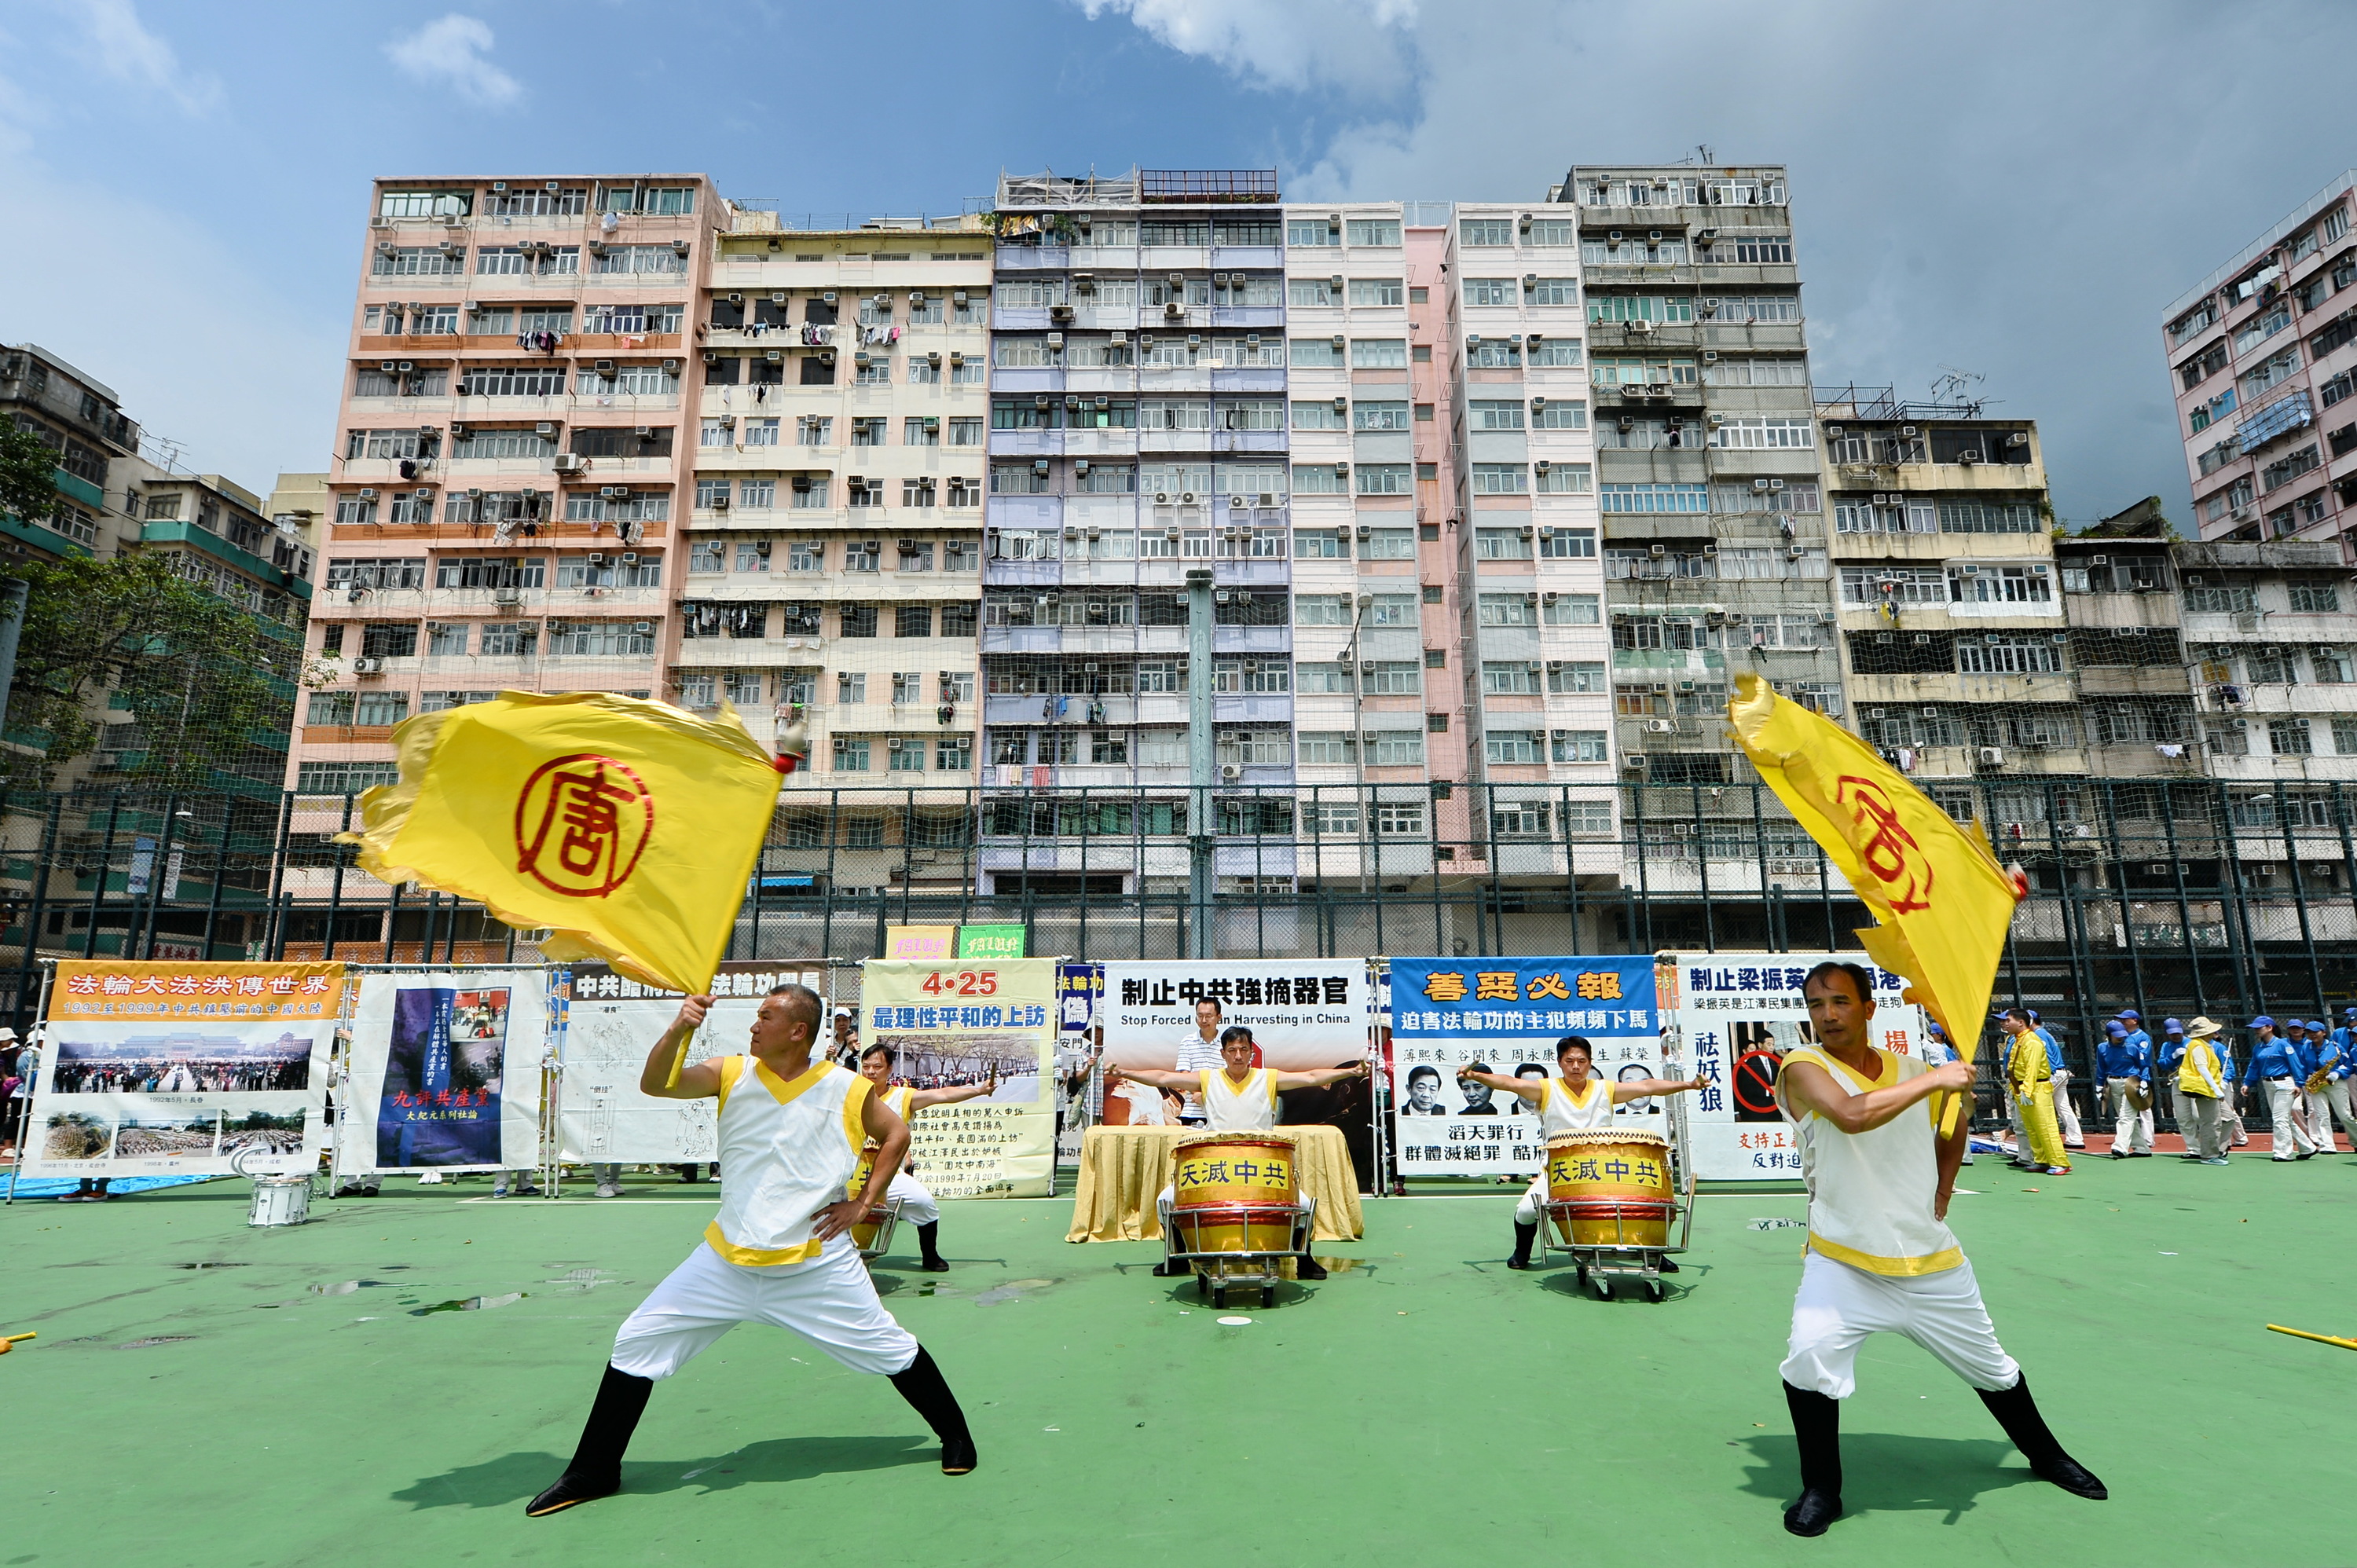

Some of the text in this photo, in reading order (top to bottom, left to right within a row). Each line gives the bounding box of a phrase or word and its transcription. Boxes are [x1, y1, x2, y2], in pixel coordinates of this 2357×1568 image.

[68, 973, 331, 997] 法輪大法洪傳世界
[1121, 976, 1349, 1006] 制止中共強摘器官
[1423, 972, 1623, 1002] 善惡必報
[872, 1005, 1047, 1030] 最理性平和的上訪
[1121, 1014, 1147, 1028] Stop
[1152, 1013, 1191, 1025] Forced
[1234, 1013, 1299, 1027] Harvesting
[1303, 1013, 1312, 1024] in
[1316, 1013, 1351, 1024] China
[1401, 1010, 1648, 1031] 迫害法輪功的主犯頻頻下馬
[1512, 1047, 1556, 1062] 周永康
[1695, 1031, 1724, 1112] 祛妖狼
[392, 1087, 490, 1108] 九評共產黨
[405, 1110, 478, 1120] 大紀元系列社論
[914, 1108, 1025, 1119] 意說明真相的萬人申訴
[1448, 1124, 1524, 1141] 滔天罪行
[1405, 1145, 1501, 1161] 群體滅絕罪
[1181, 1160, 1286, 1187] 天滅中共
[1552, 1158, 1659, 1186] 天滅中共
